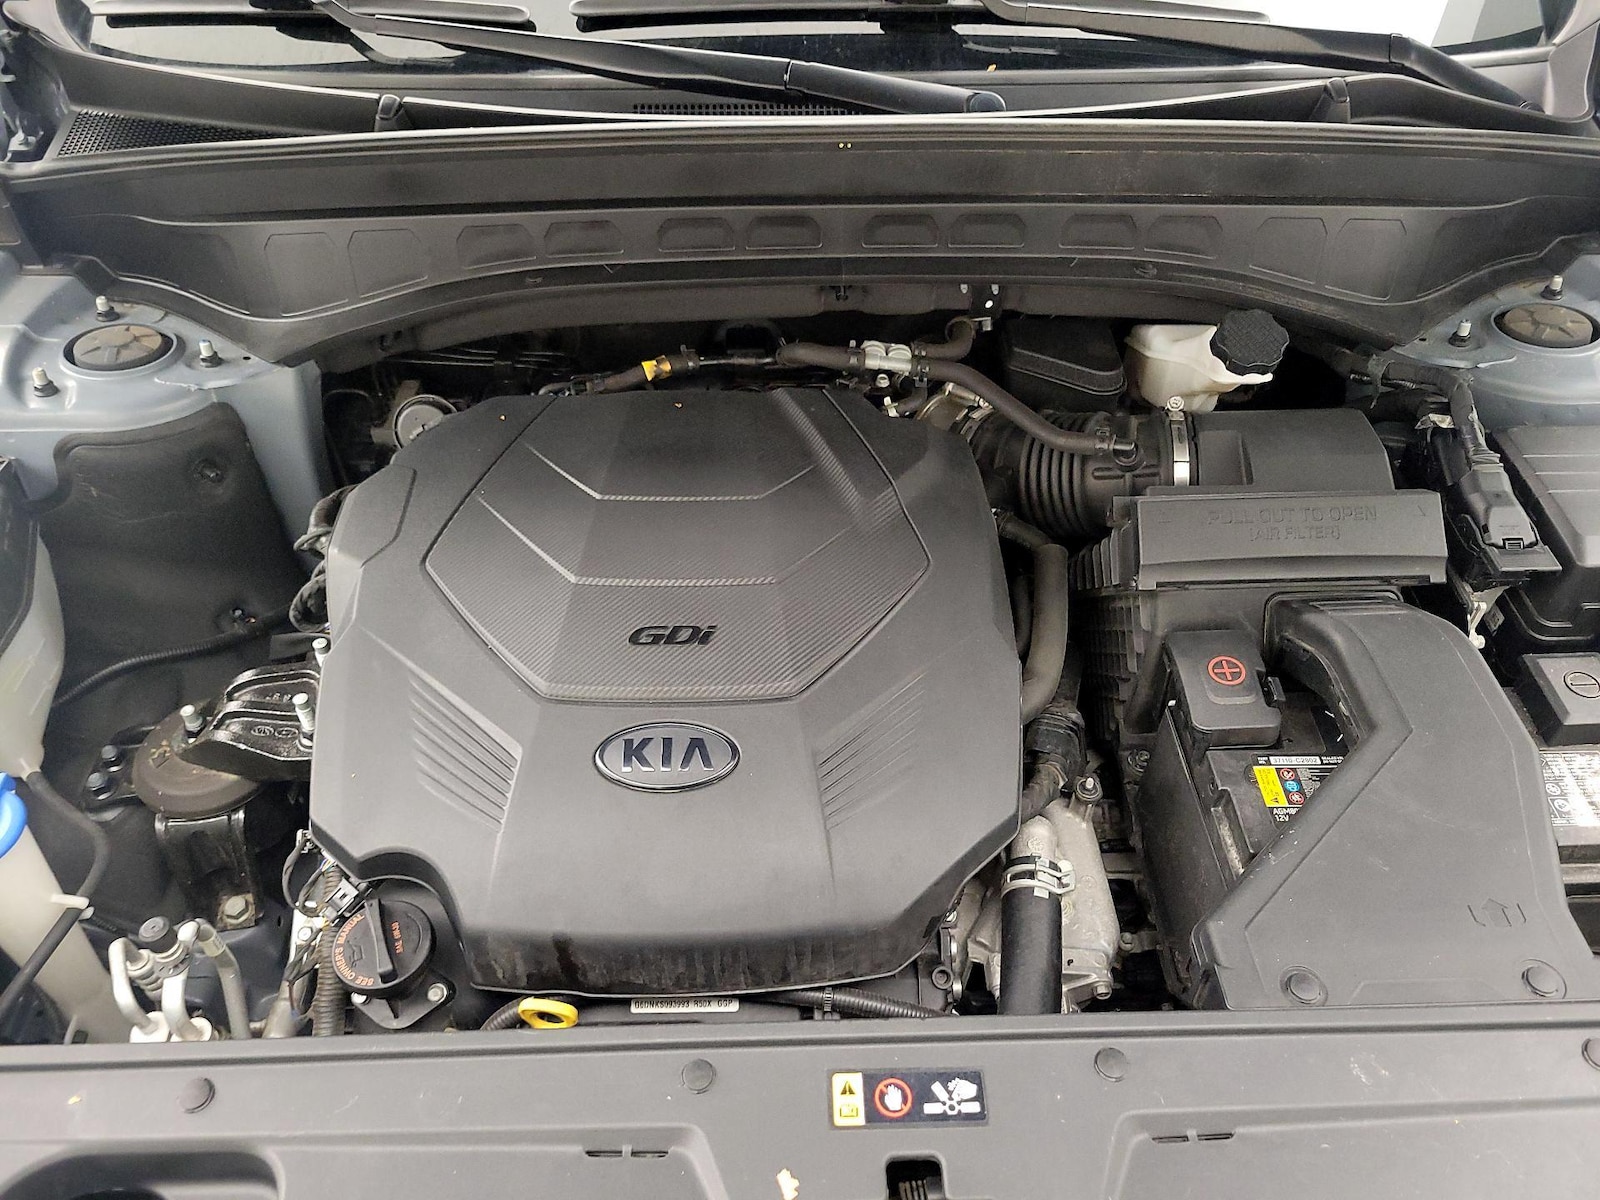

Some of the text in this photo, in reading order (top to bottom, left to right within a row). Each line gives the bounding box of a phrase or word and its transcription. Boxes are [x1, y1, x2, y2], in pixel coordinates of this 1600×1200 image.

[1208, 505, 1378, 525] PULL OUT TO OPEN
[628, 625, 718, 646] GDi
[621, 736, 715, 773] KIA
[334, 913, 374, 986] SEE OWNER'S MANUAL
